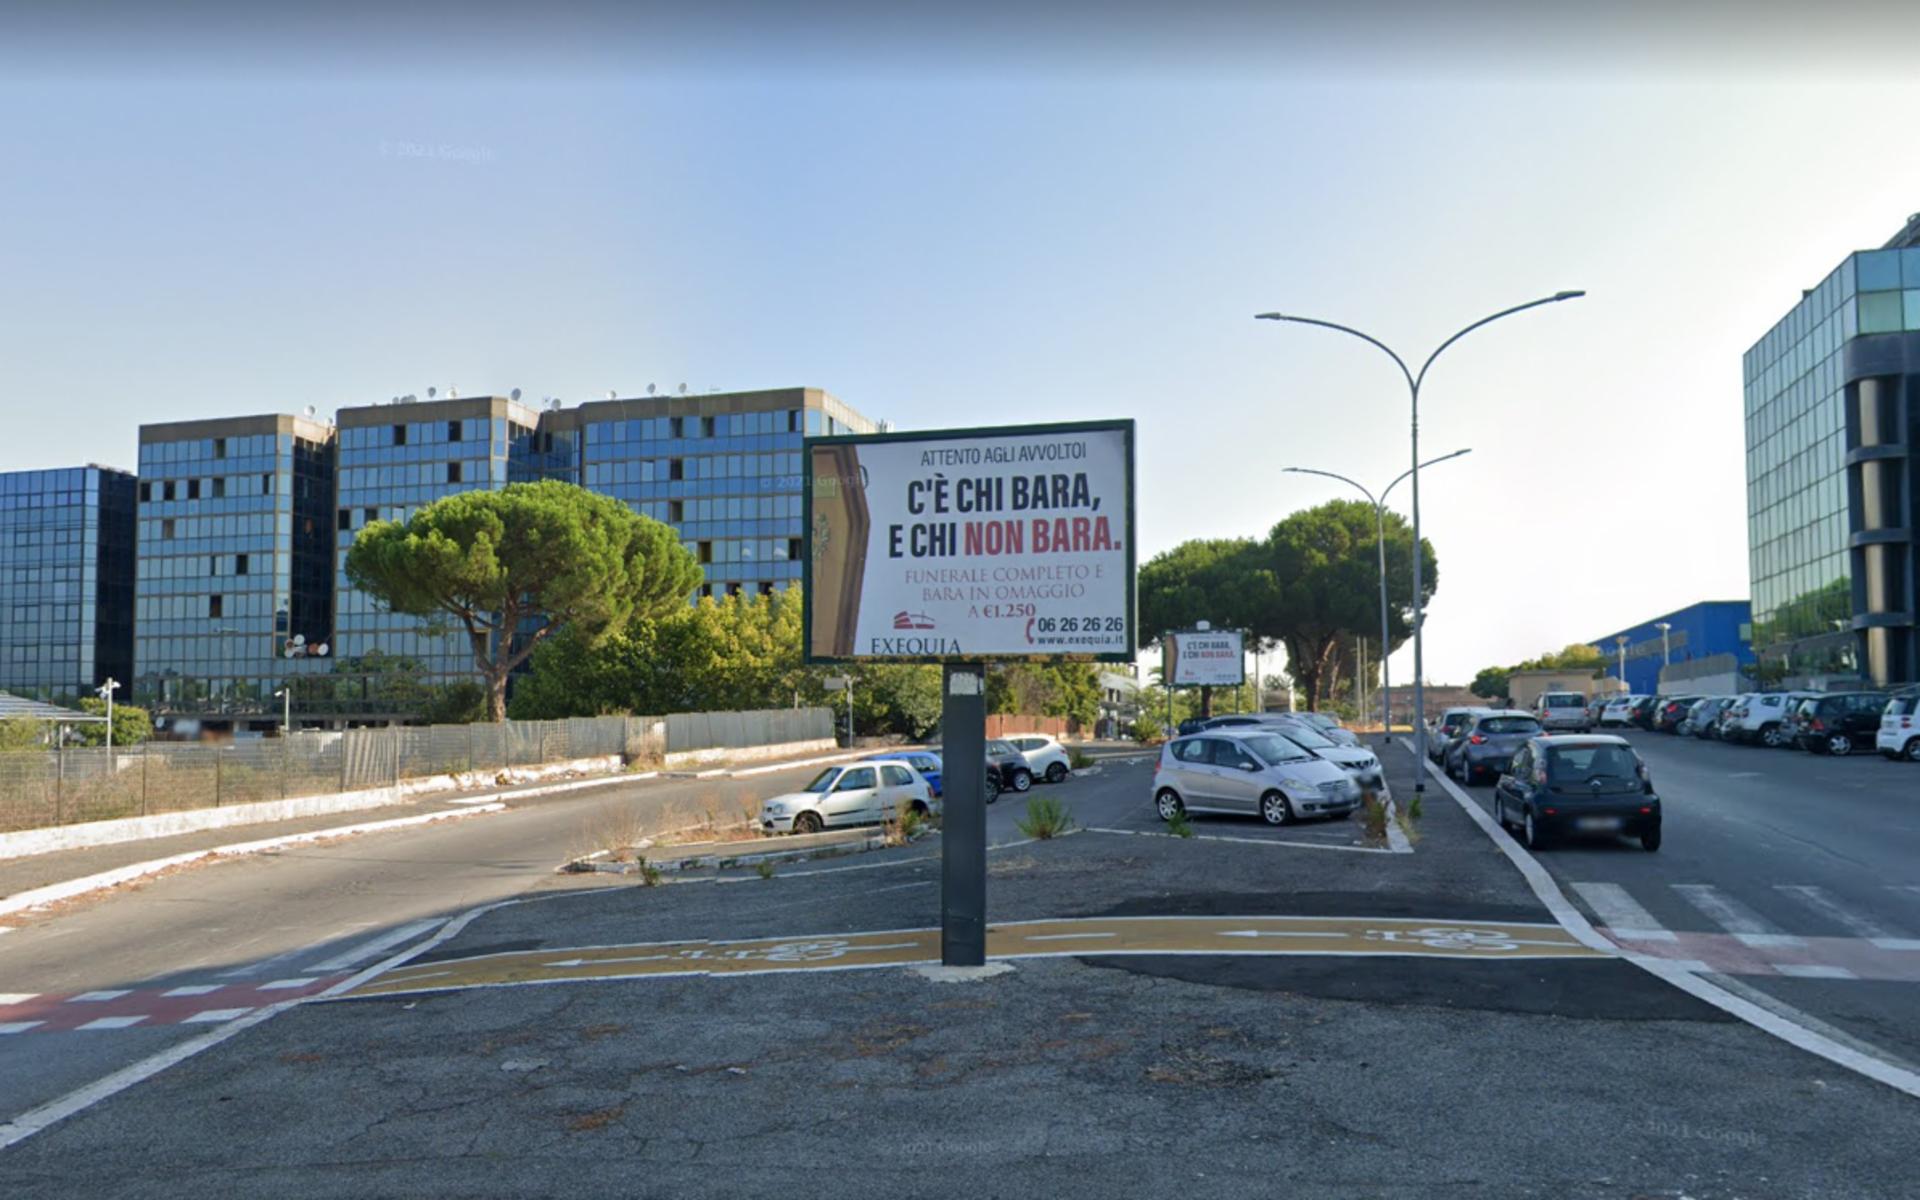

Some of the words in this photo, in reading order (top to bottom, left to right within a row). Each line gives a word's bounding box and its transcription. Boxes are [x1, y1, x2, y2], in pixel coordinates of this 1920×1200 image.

[921, 448, 981, 466] ATTENTO
[984, 446, 1015, 463] AGLI
[1018, 442, 1087, 461] AVVOLTOI
[907, 472, 949, 515] C'È
[956, 477, 1003, 513] CHI
[1012, 472, 1101, 511] BARA,
[889, 524, 904, 558] E
[910, 522, 957, 557] CHI
[964, 519, 1024, 556] NON
[1032, 516, 1122, 553] BARA.
[905, 567, 988, 584] FUNERALE
[993, 565, 1090, 582] COMPLETO
[1095, 564, 1104, 578] E
[922, 585, 963, 601] BARA
[970, 585, 989, 600] IN
[995, 583, 1085, 600] OMAGGIO
[968, 605, 980, 618] A
[983, 603, 1037, 618] €1.250
[1038, 617, 1056, 632] 06
[1060, 617, 1078, 632] 26
[1082, 617, 1101, 632] 26
[1105, 616, 1124, 632] 26
[871, 637, 962, 655] EXEQUIA
[1038, 634, 1124, 645] www.exequia.it
